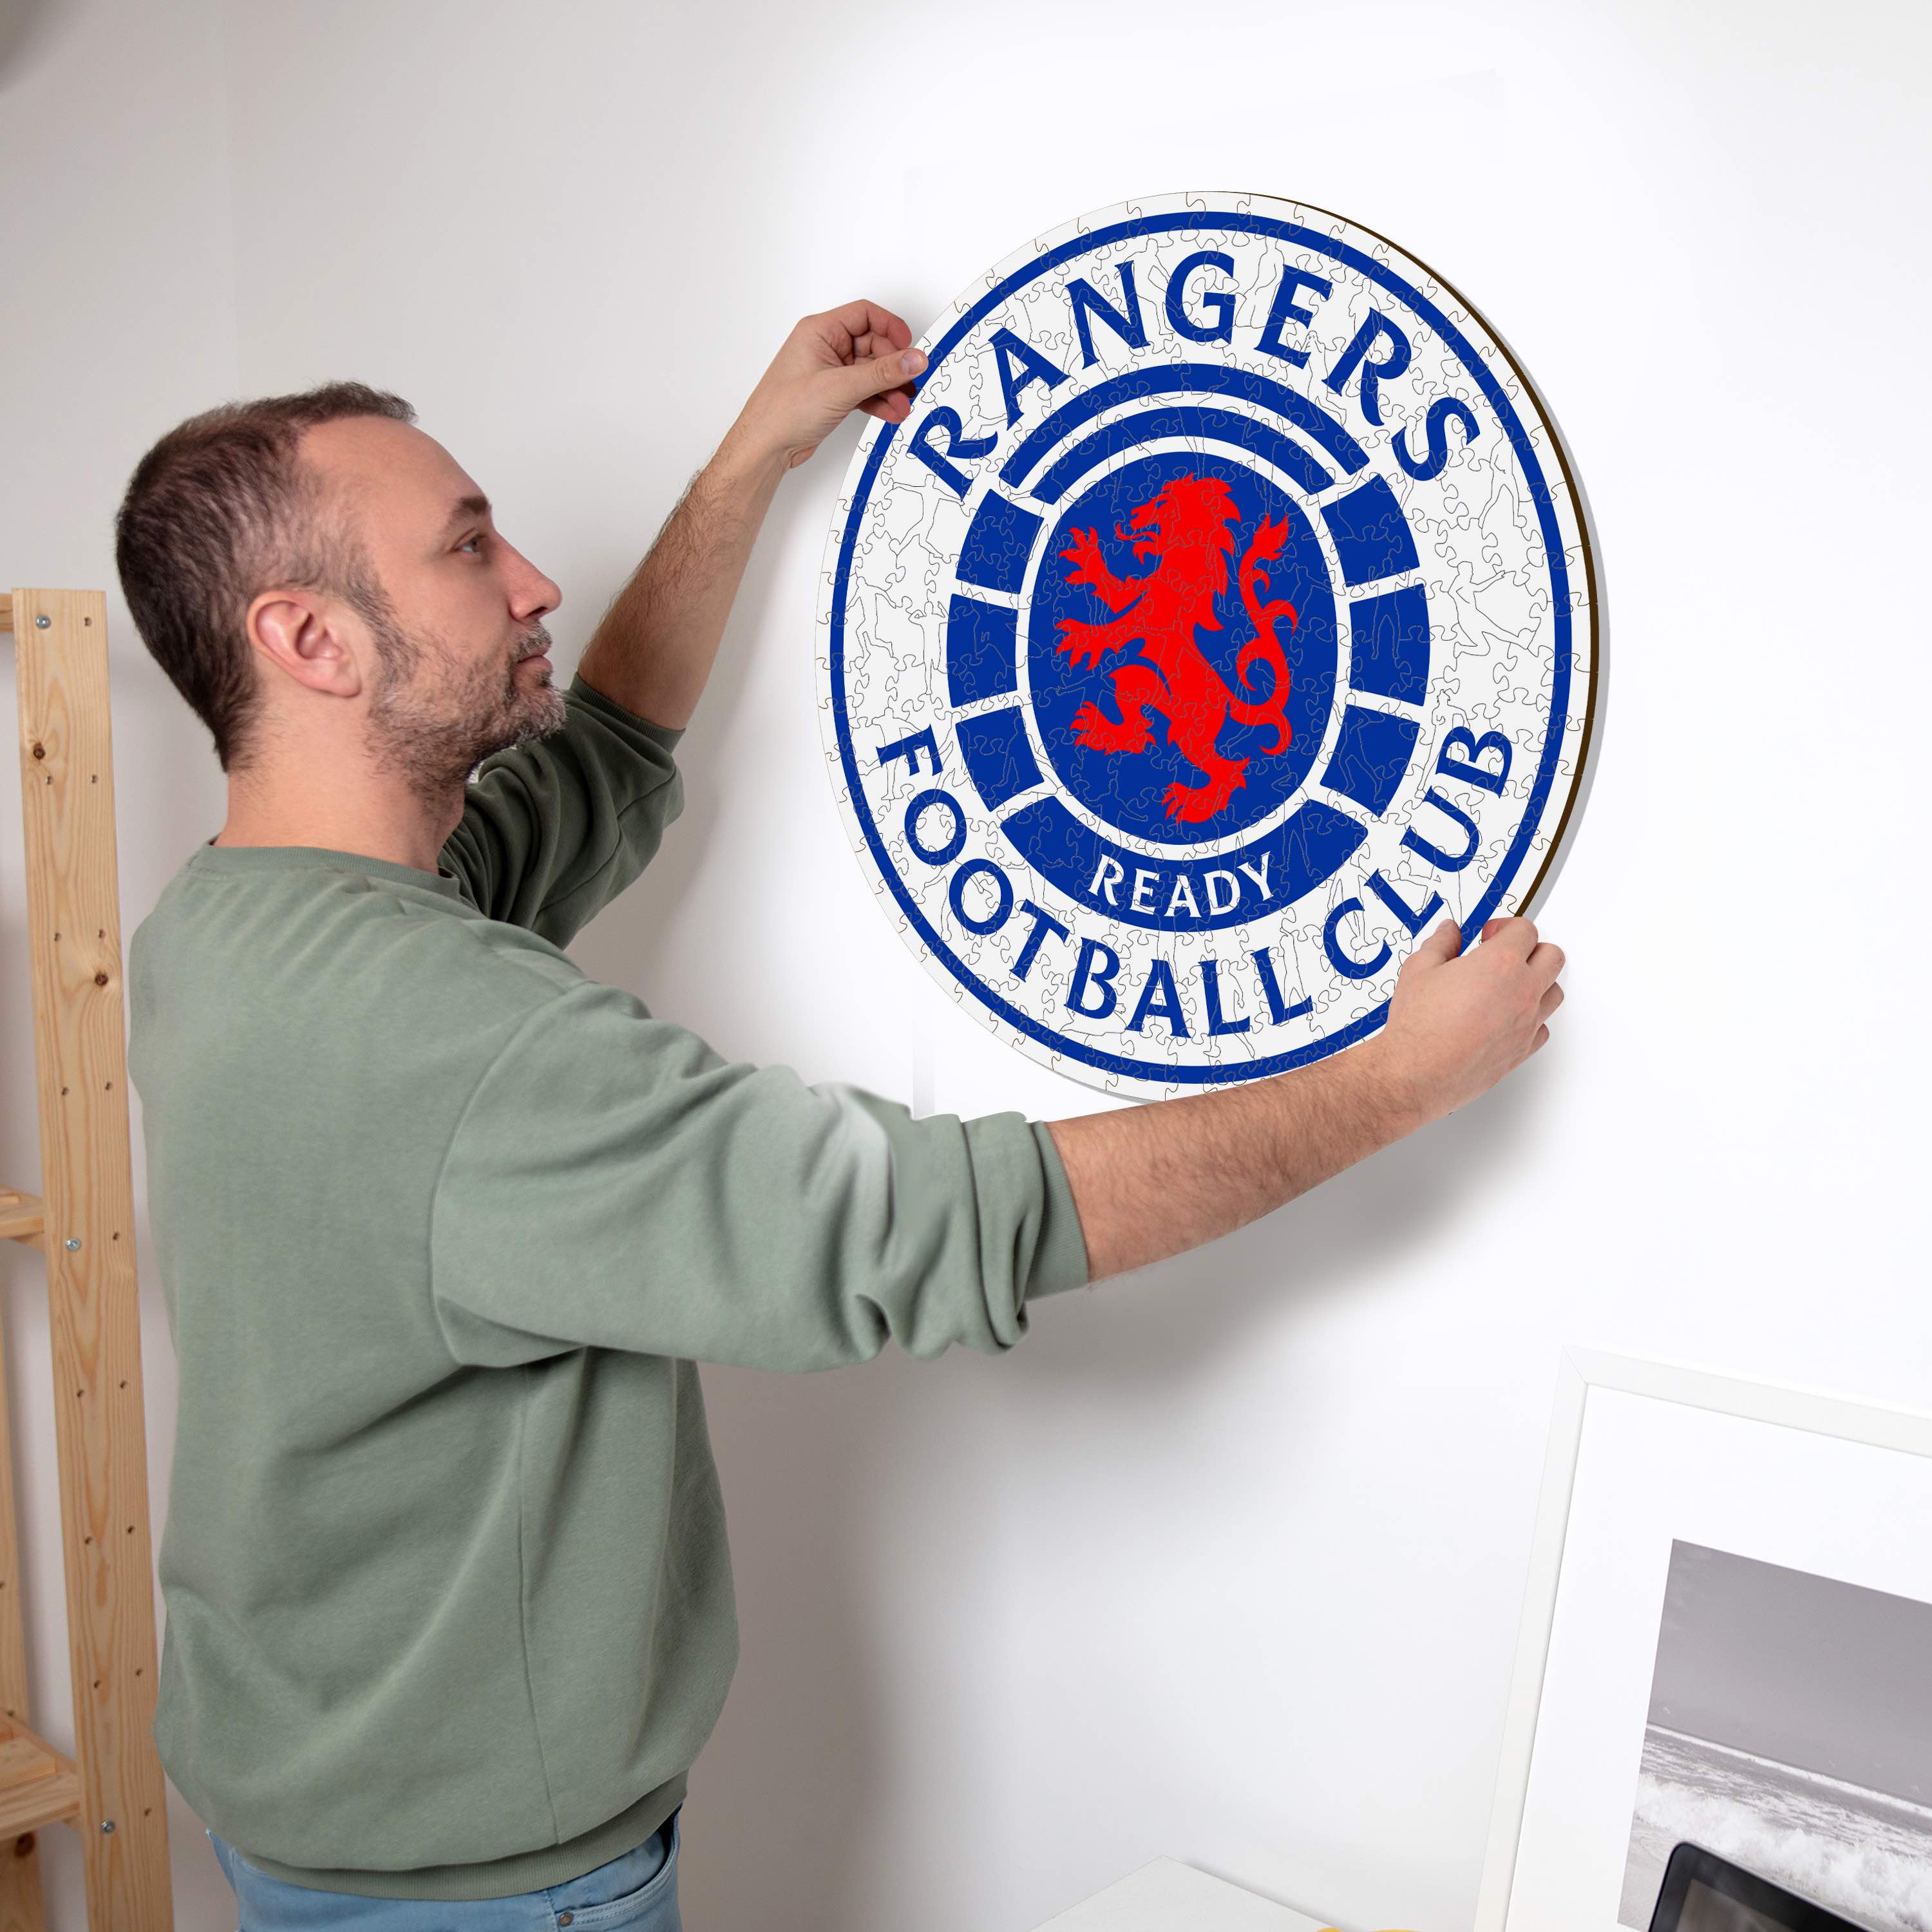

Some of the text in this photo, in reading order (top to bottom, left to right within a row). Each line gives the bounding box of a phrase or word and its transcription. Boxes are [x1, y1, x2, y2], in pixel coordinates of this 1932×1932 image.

[907, 250, 1481, 500] RANGERS
[875, 724, 1513, 1039] FOOTBALL CLUB
[1089, 851, 1275, 918] READY
